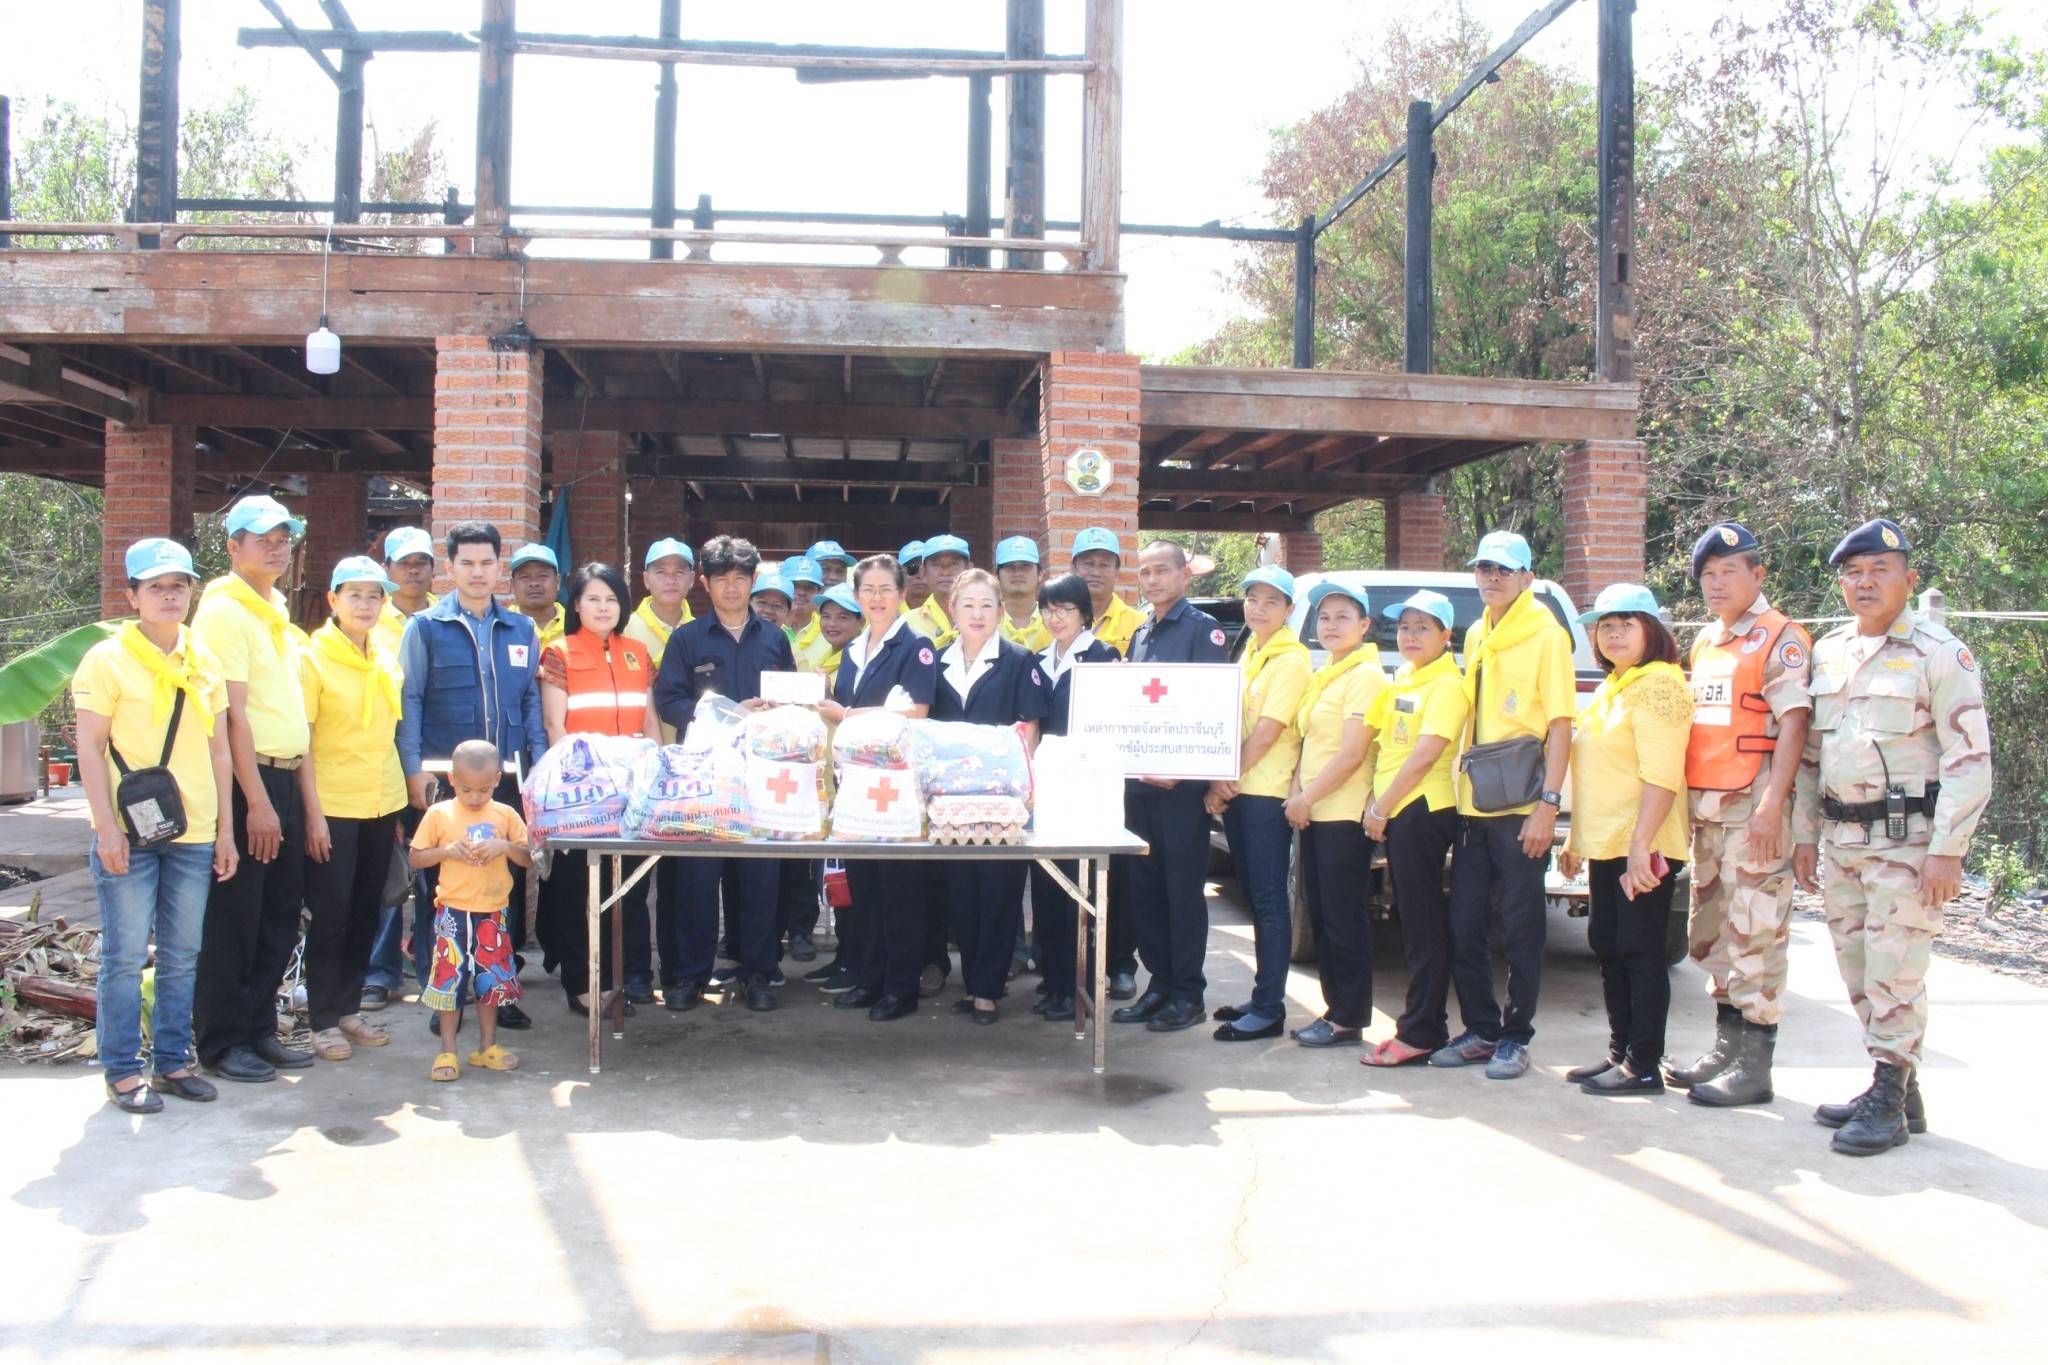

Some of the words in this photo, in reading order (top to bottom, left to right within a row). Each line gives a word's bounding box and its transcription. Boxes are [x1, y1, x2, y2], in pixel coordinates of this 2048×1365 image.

[1083, 720, 1225, 739] เหล่ากาชาดจังหวัดปราจีนบุรี
[1116, 739, 1232, 758] กข์ผู้ประสบสาธารณภัย
